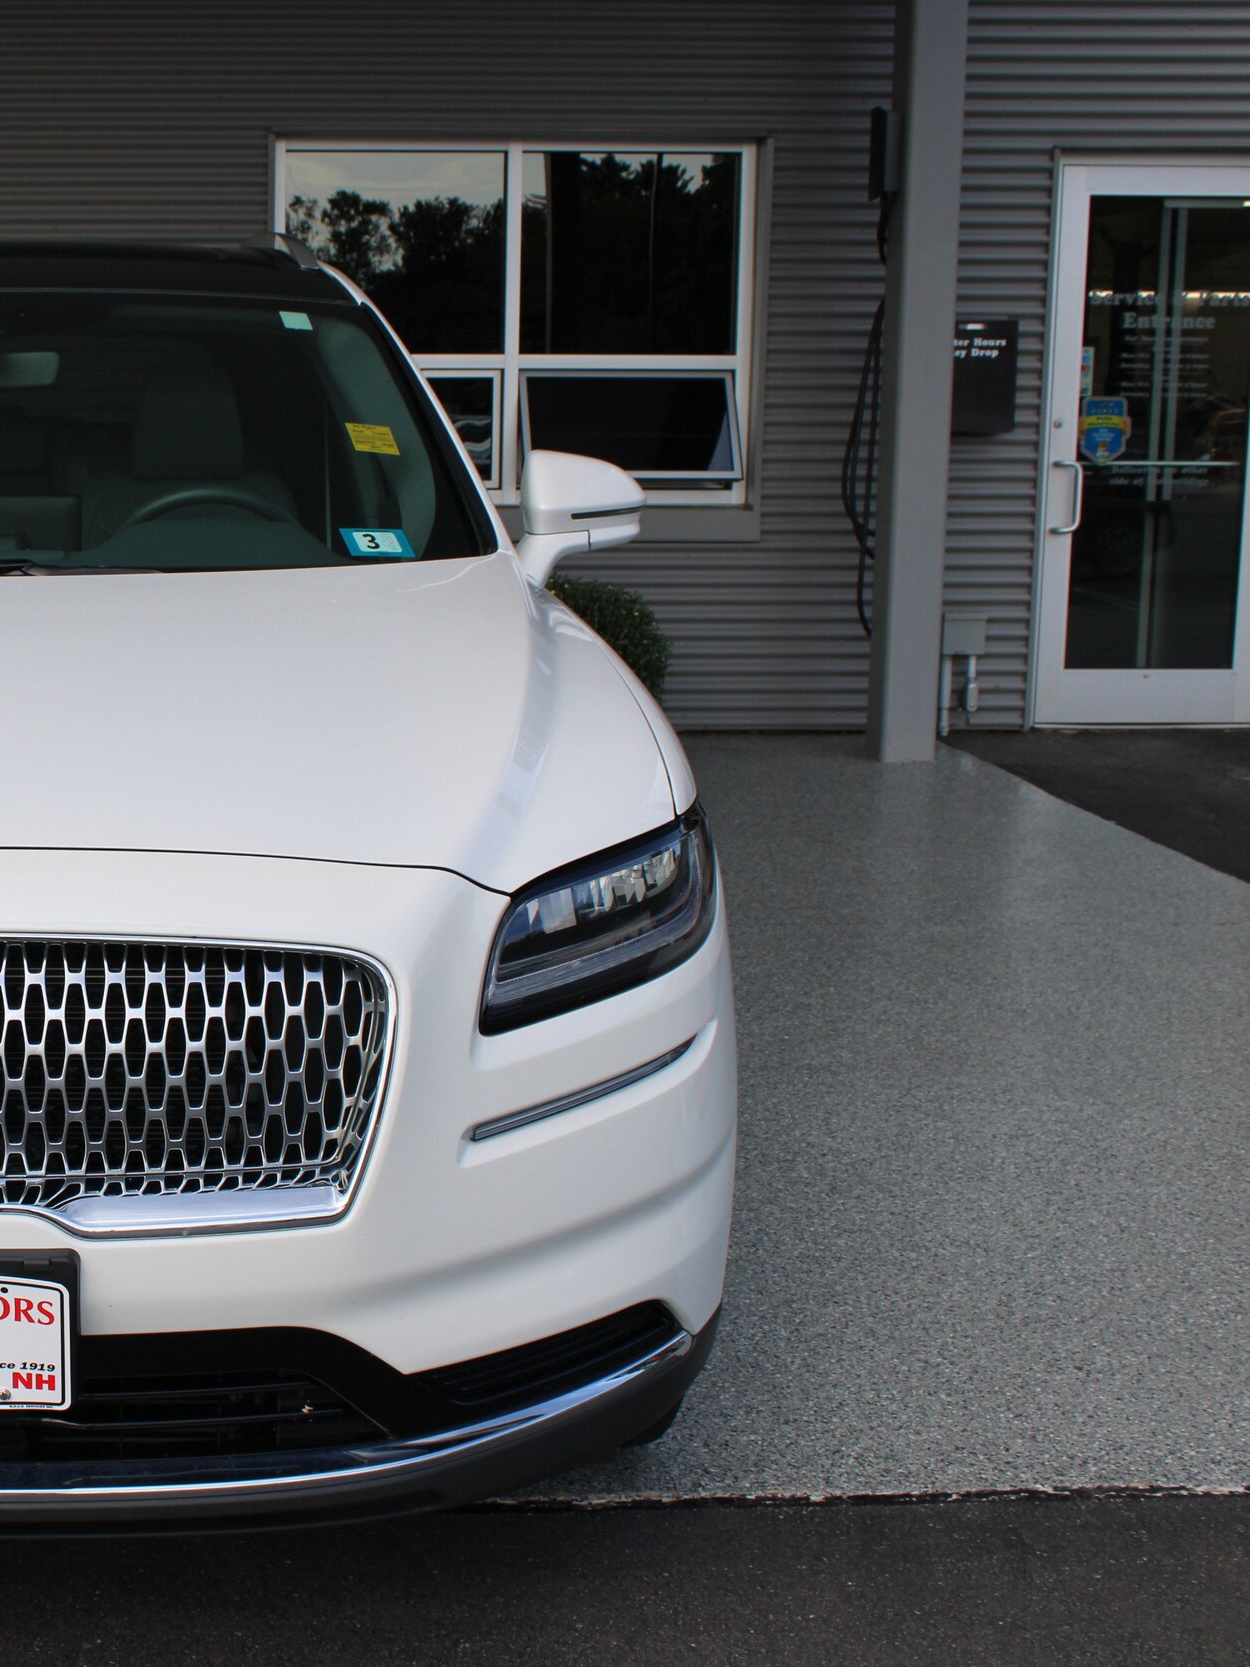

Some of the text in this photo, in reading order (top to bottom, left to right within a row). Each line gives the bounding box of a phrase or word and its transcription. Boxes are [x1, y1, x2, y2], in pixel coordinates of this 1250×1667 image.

[1122, 312, 1216, 329] Entrance
[973, 337, 1007, 347] Hours
[971, 347, 999, 358] Drop
[361, 532, 382, 551] 3
[19, 1361, 56, 1373] 1919
[12, 1371, 57, 1392] NH
